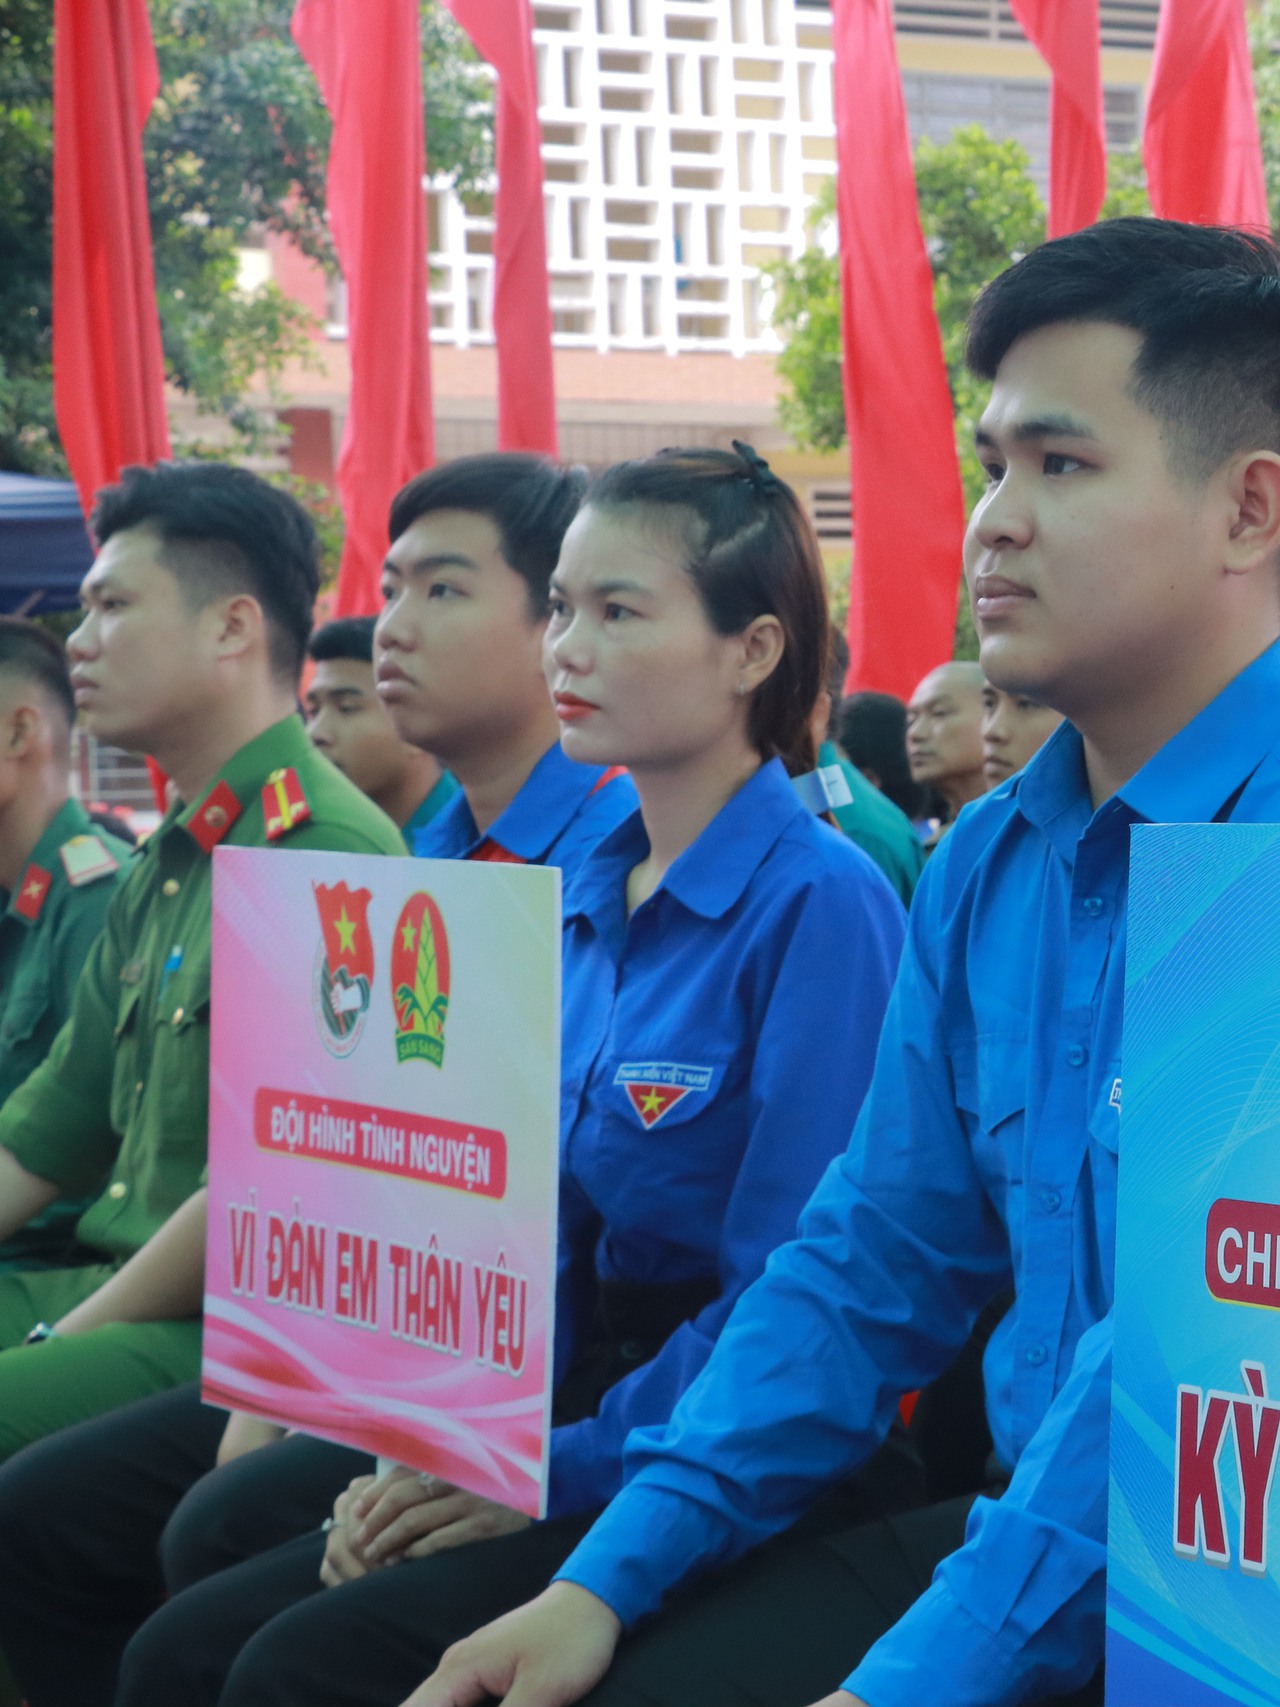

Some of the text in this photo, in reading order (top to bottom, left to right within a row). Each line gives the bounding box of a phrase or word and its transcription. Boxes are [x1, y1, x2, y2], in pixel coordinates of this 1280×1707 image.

[270, 1099, 491, 1190] ĐỘI HÌNH TÌNH NGUYỆN
[227, 1187, 528, 1379] VÌ ĐÀN EM THÂN YÊU
